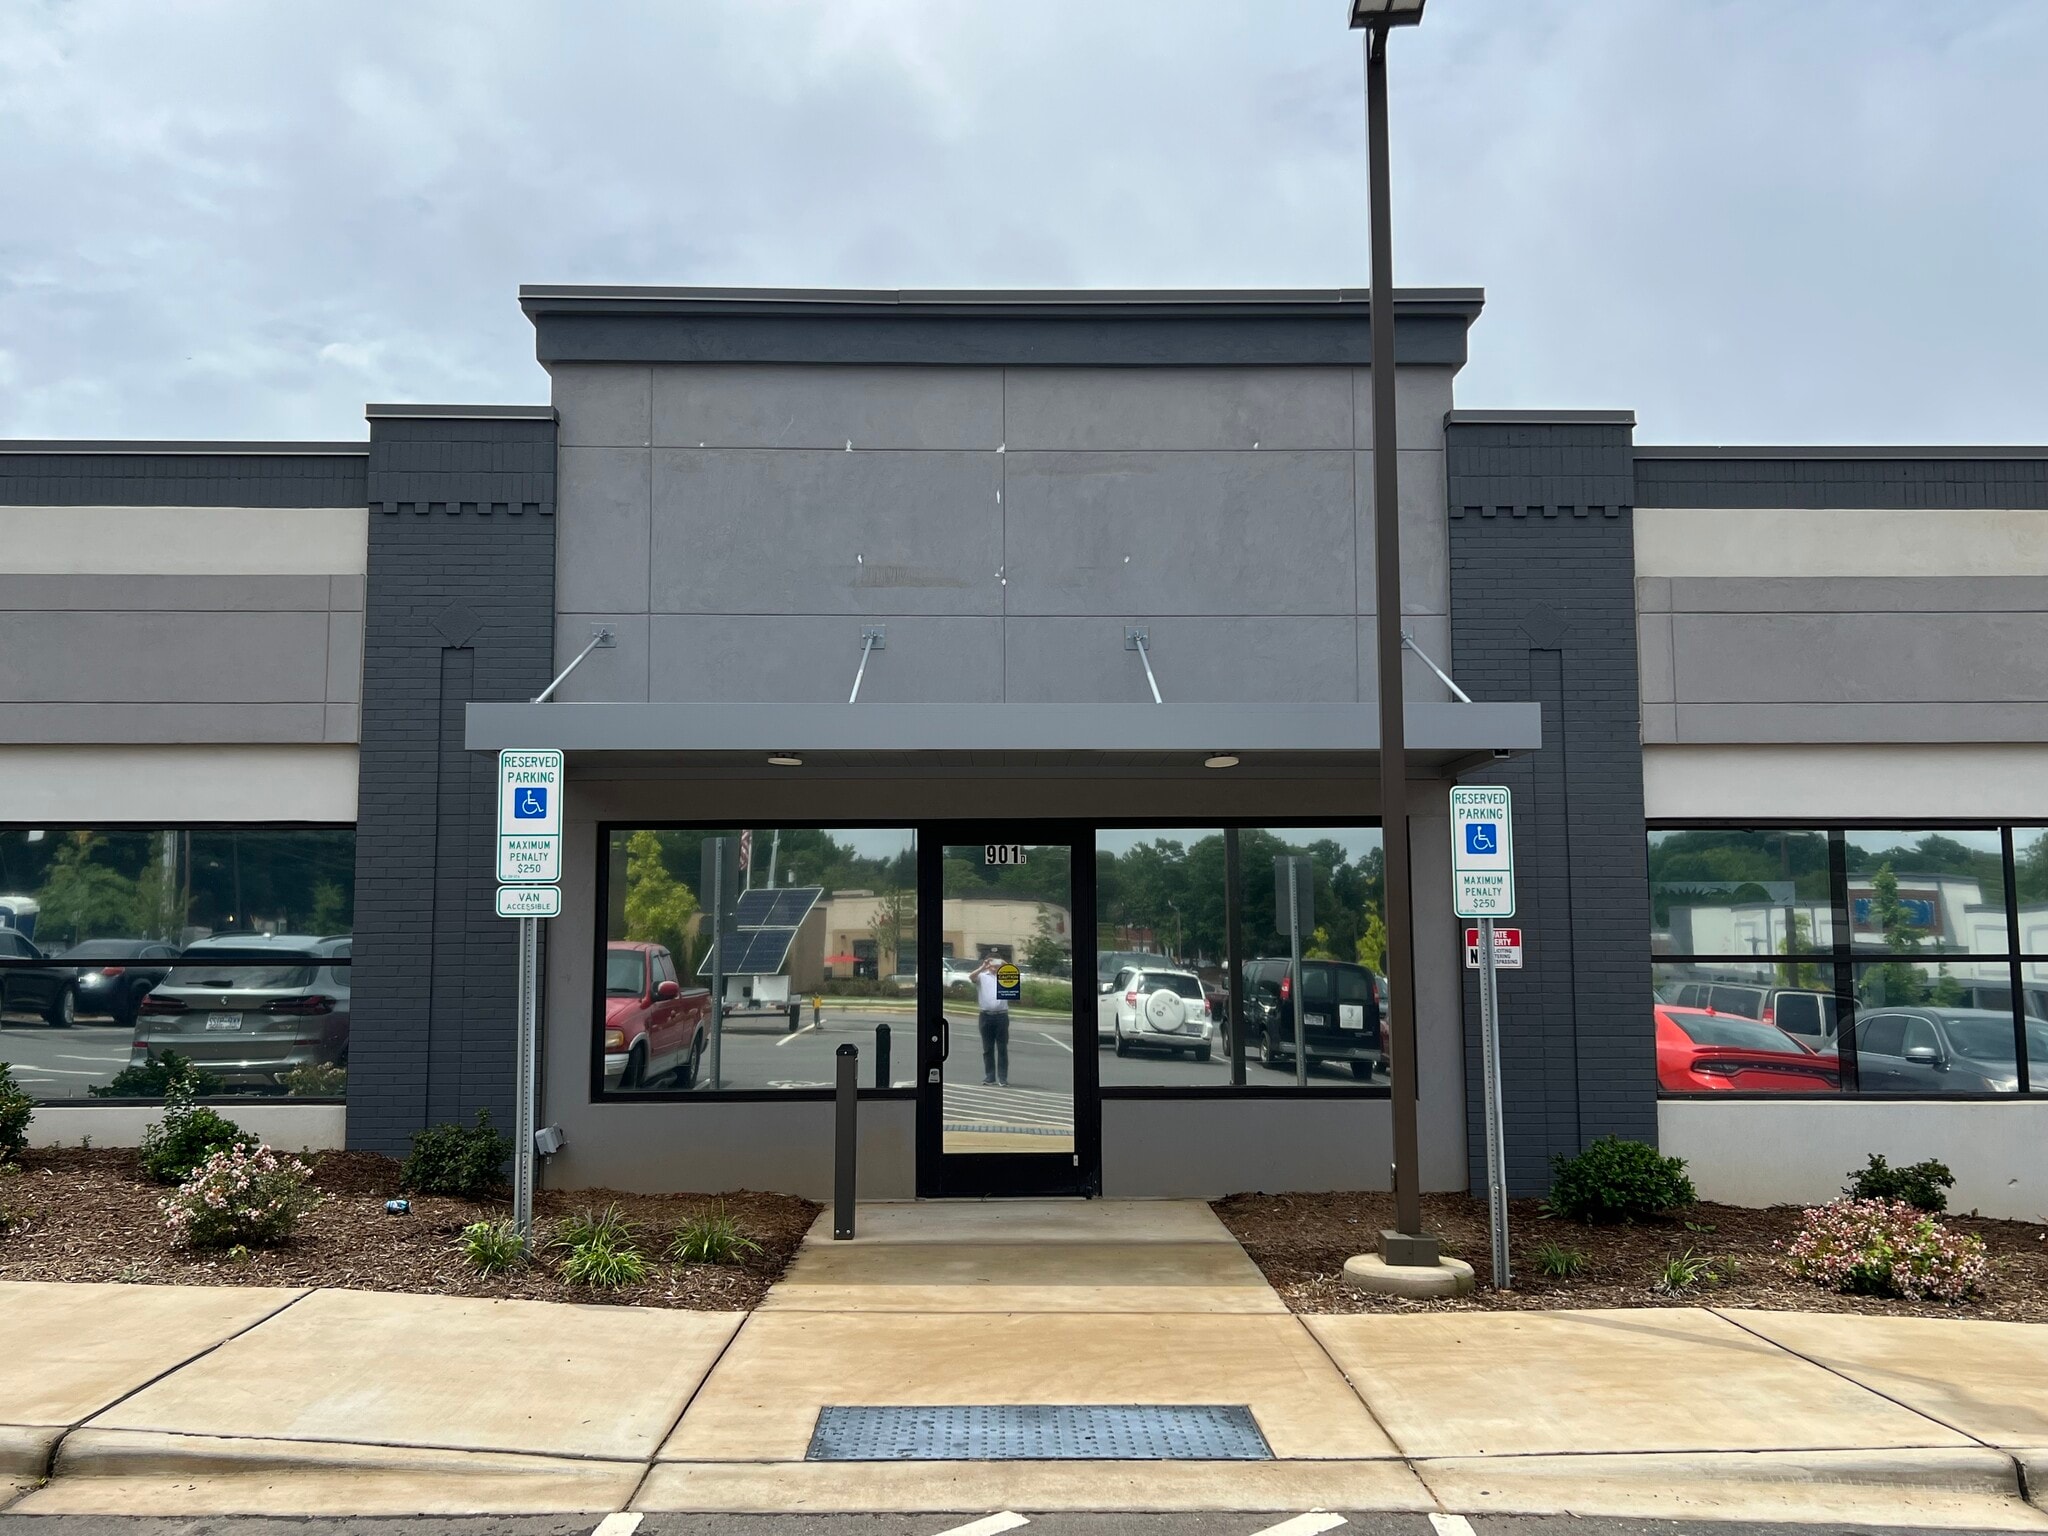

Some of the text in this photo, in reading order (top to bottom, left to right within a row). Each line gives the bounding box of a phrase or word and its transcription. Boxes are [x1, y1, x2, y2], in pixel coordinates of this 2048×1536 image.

[504, 756, 558, 767] RESERVED
[508, 772, 554, 783] PARKING
[1455, 793, 1506, 804] RESERVED
[1459, 808, 1503, 819] PARKING
[509, 841, 550, 849] MAXIMUM
[510, 853, 548, 861] PENALTY
[517, 863, 541, 873] $250
[1464, 876, 1503, 885] MAXIMUM
[1465, 888, 1502, 896] PENALTY
[519, 893, 540, 902] VAN
[1473, 899, 1496, 908] $250
